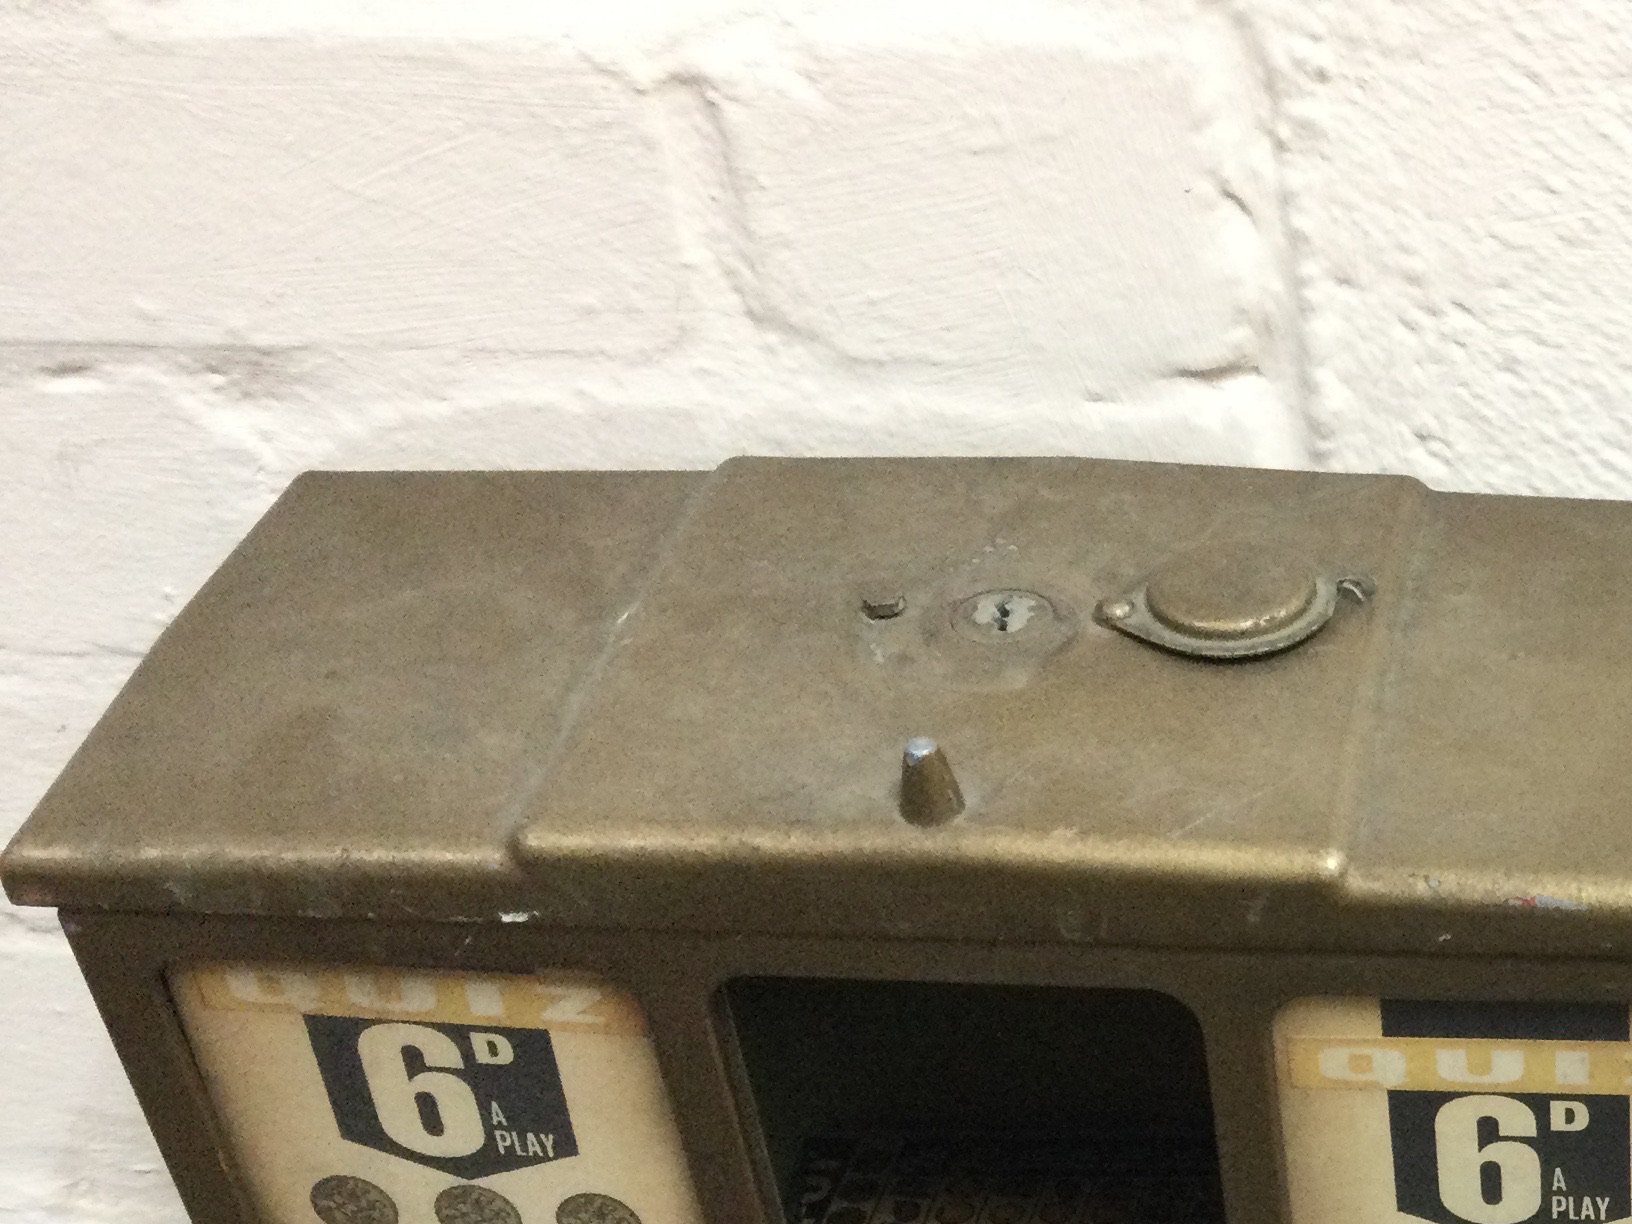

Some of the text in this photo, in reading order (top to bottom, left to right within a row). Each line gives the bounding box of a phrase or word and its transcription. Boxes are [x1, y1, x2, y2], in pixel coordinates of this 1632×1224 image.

[490, 1101, 507, 1127] A
[494, 1129, 562, 1159] PLAY
[1552, 1167, 1567, 1192] A
[1551, 1196, 1611, 1222] PLAY
